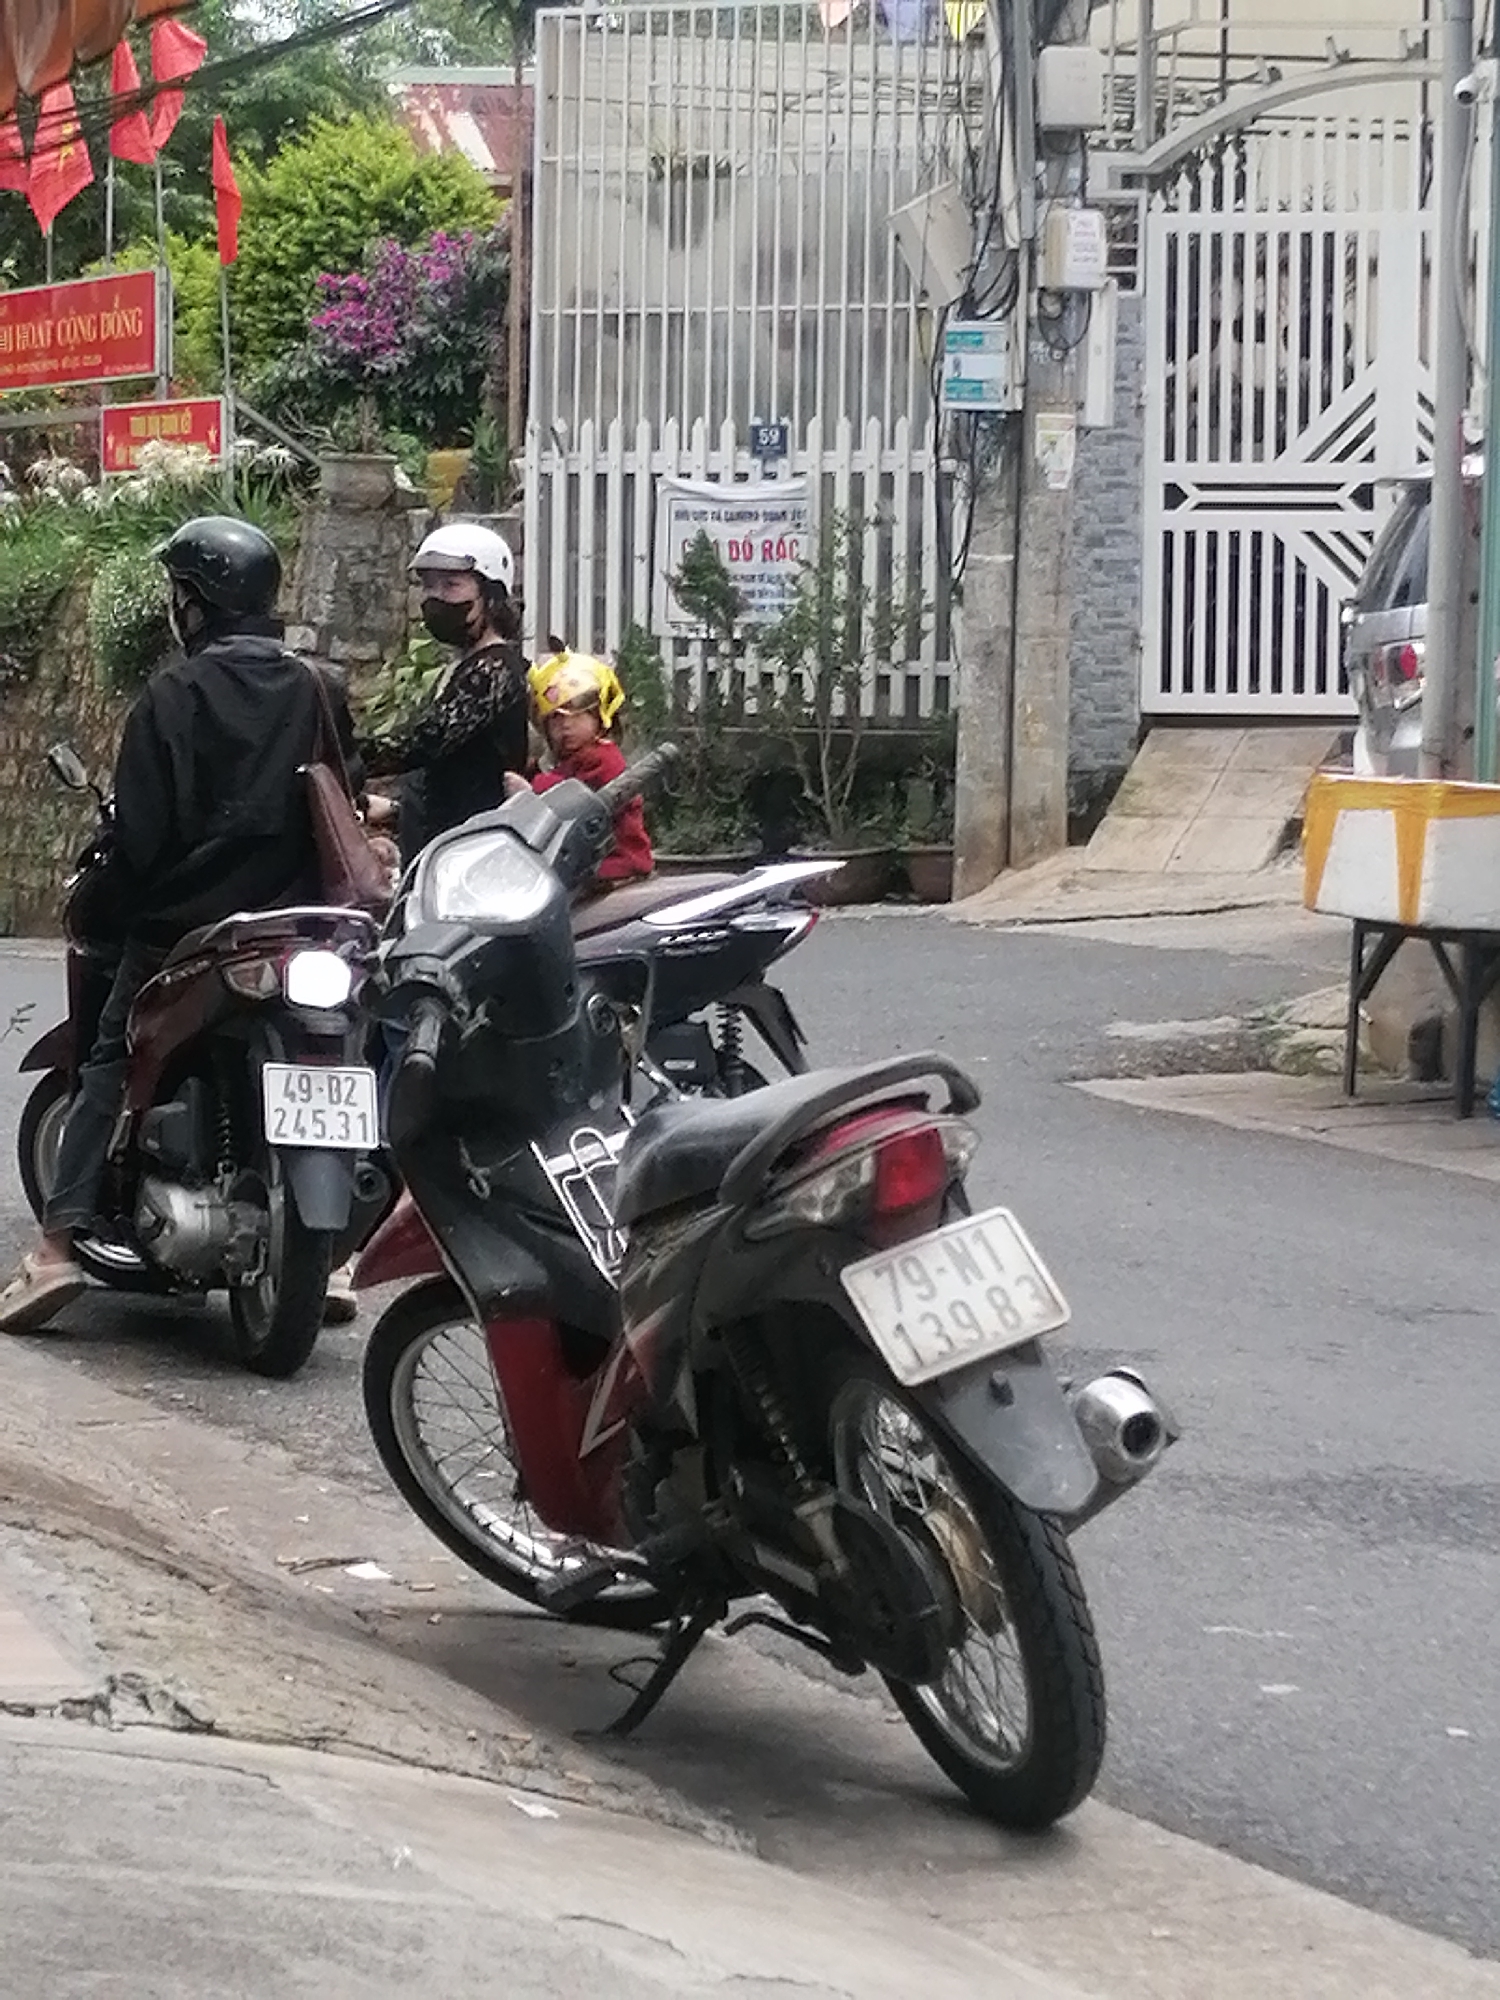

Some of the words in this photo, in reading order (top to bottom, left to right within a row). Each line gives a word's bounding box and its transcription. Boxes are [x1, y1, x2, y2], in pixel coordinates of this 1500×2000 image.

[759, 428, 779, 446] 59
[273, 1107, 368, 1142] 245.31
[873, 1227, 1006, 1314] 79-N1
[893, 1274, 1046, 1367] 139.83
